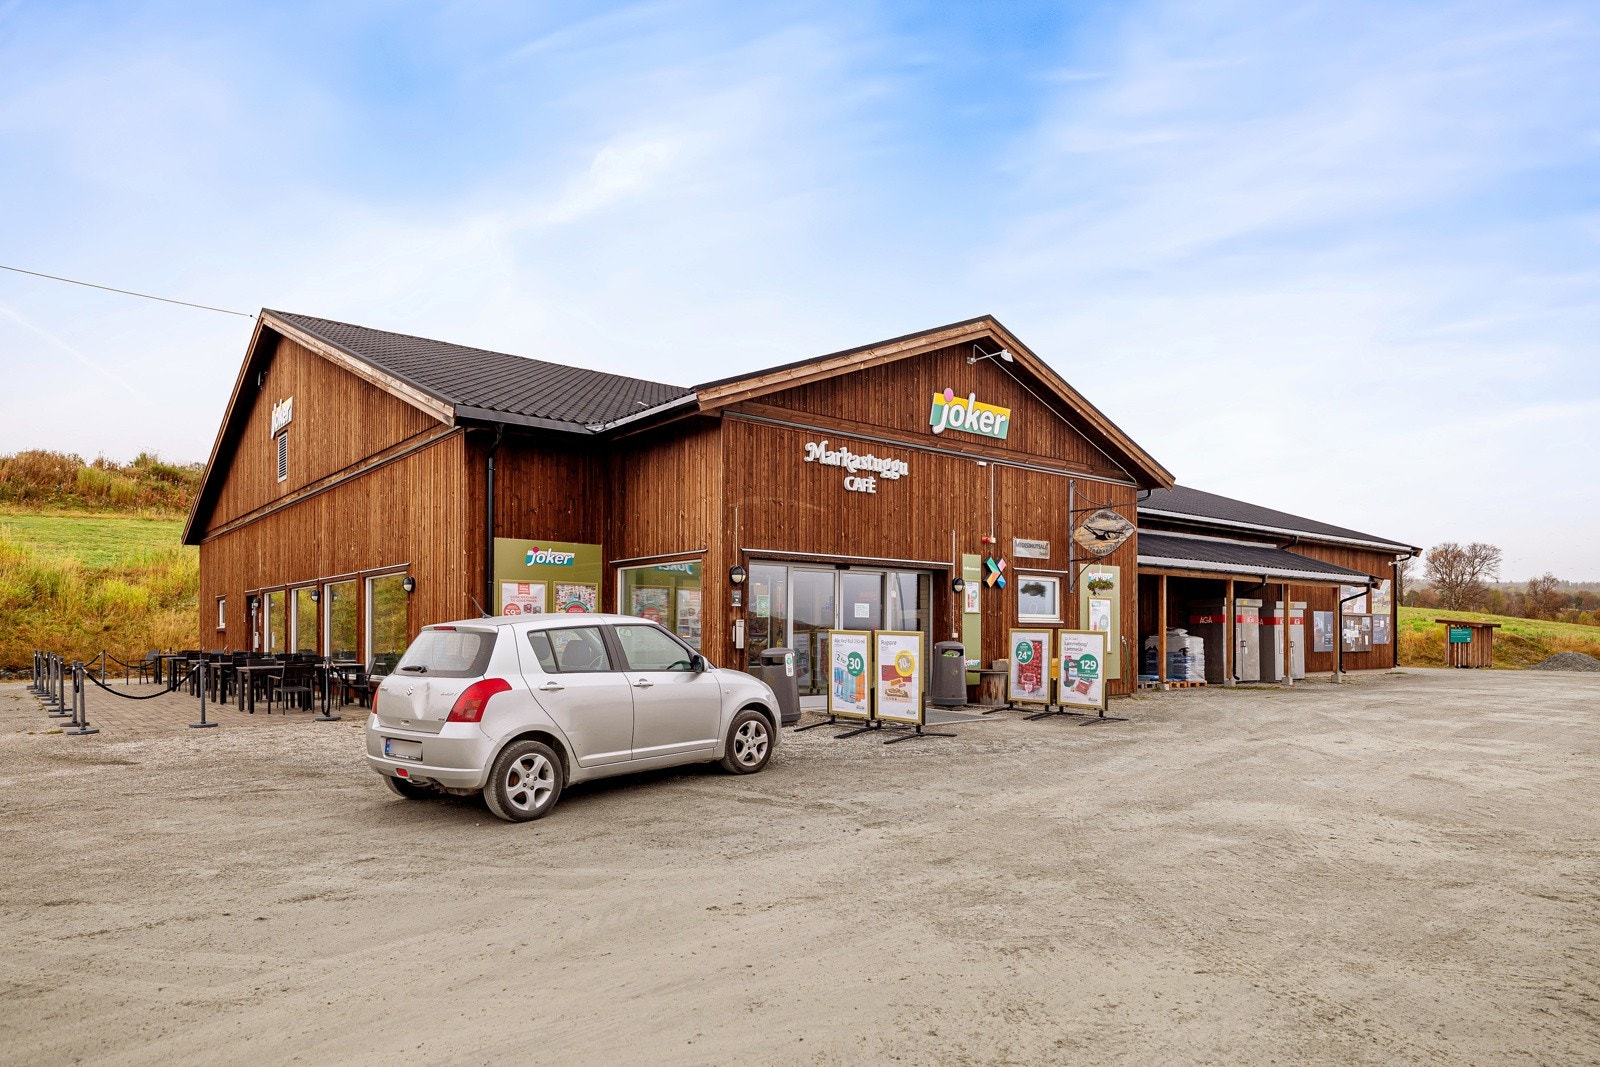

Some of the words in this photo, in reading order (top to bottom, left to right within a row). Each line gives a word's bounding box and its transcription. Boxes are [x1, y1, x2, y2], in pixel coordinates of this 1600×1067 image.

[931, 388, 1006, 435] joker
[804, 440, 909, 480] Markastuggu
[526, 547, 573, 567] joker
[848, 657, 861, 670] 30
[1017, 651, 1028, 660] 24
[1080, 659, 1097, 670] 129
